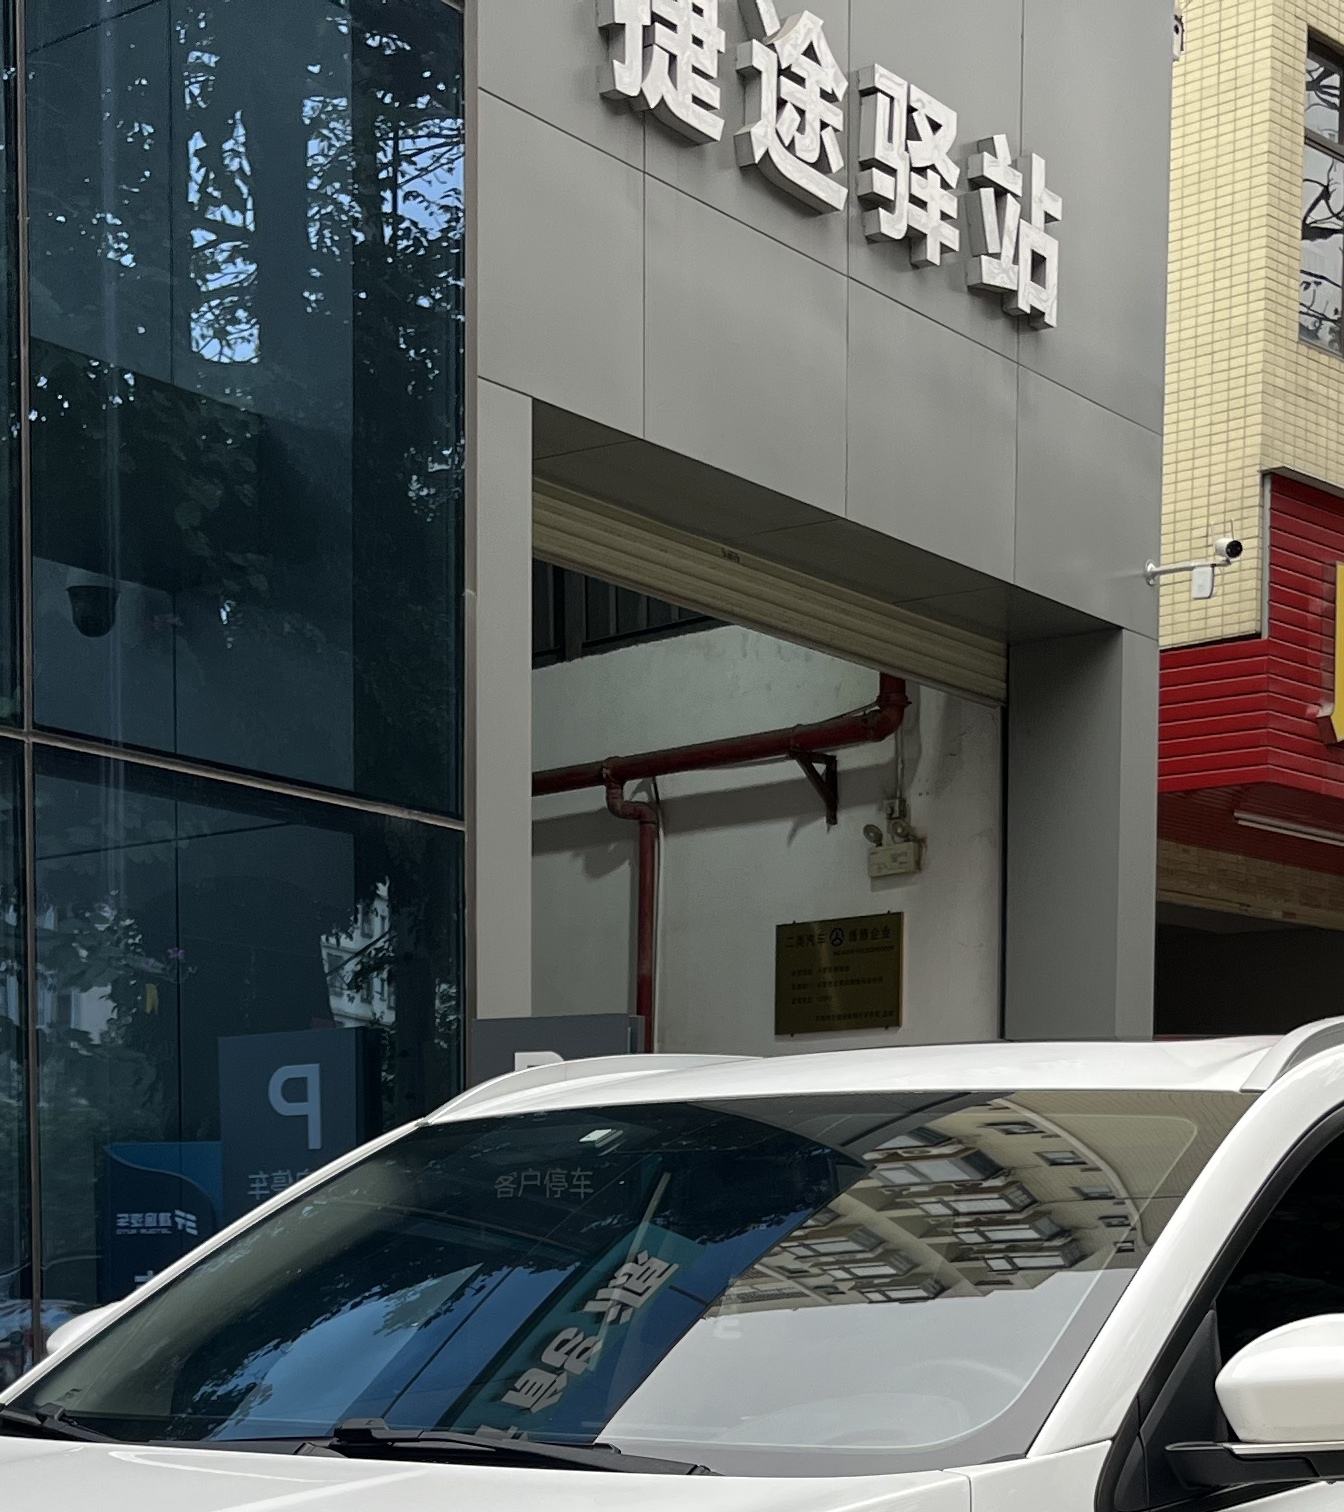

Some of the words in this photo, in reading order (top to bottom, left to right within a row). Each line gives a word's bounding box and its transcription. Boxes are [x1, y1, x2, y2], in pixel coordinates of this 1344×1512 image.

[599, 0, 1062, 328] 捷途驿站
[494, 1167, 594, 1199] 客户停车
